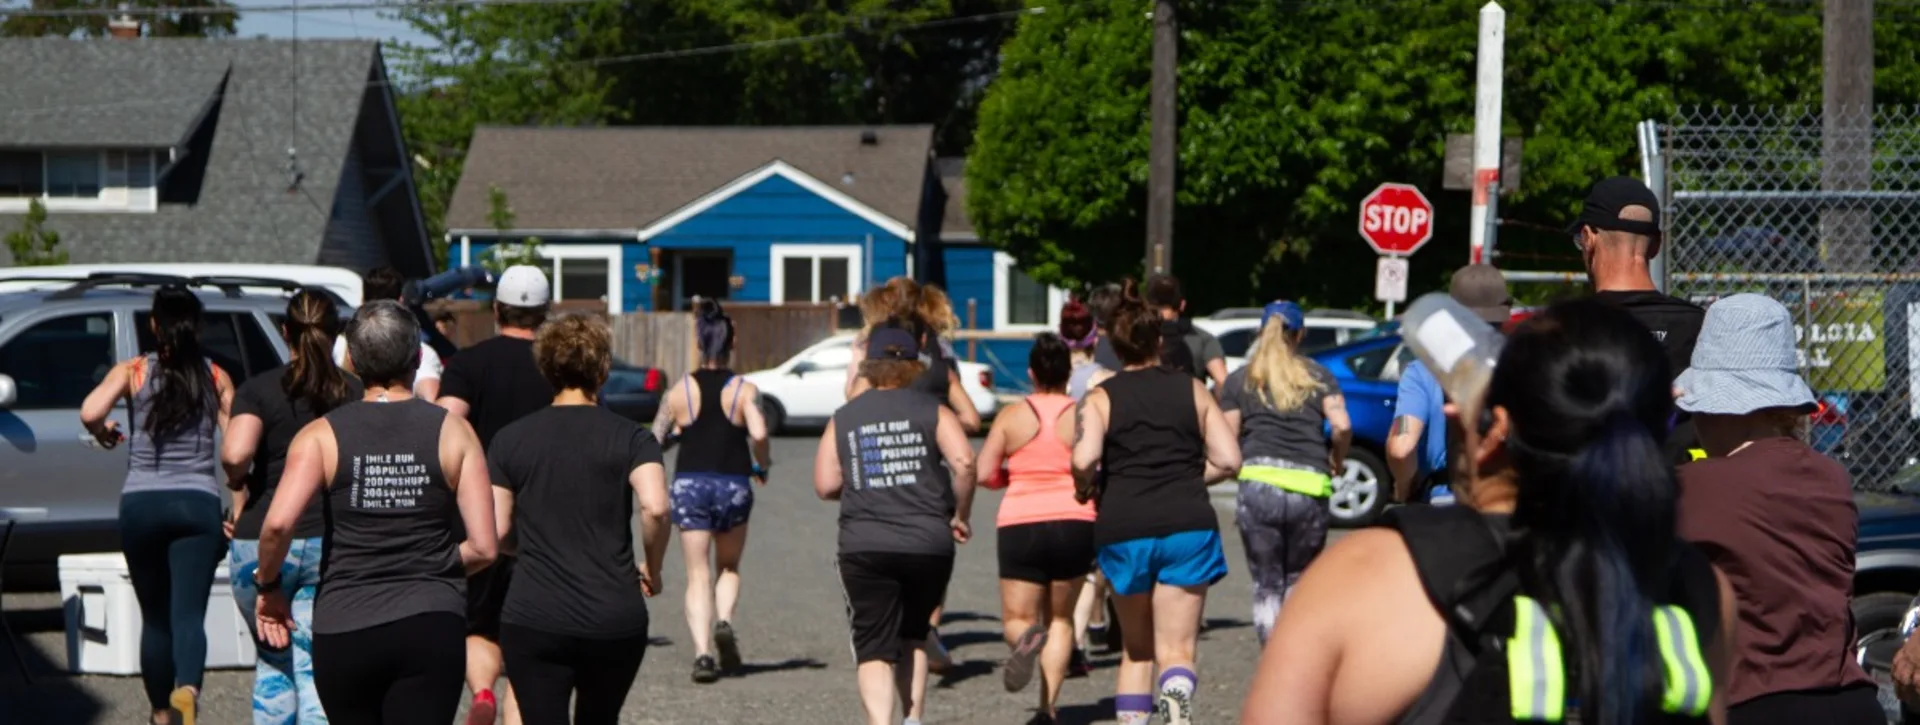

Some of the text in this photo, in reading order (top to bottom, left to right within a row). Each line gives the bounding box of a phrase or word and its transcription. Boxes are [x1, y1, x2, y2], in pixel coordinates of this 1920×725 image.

[1365, 204, 1428, 235] STOP
[888, 419, 910, 432] RUN
[394, 453, 415, 464] RUN
[895, 474, 917, 485] RUN
[394, 498, 416, 508] RUN
